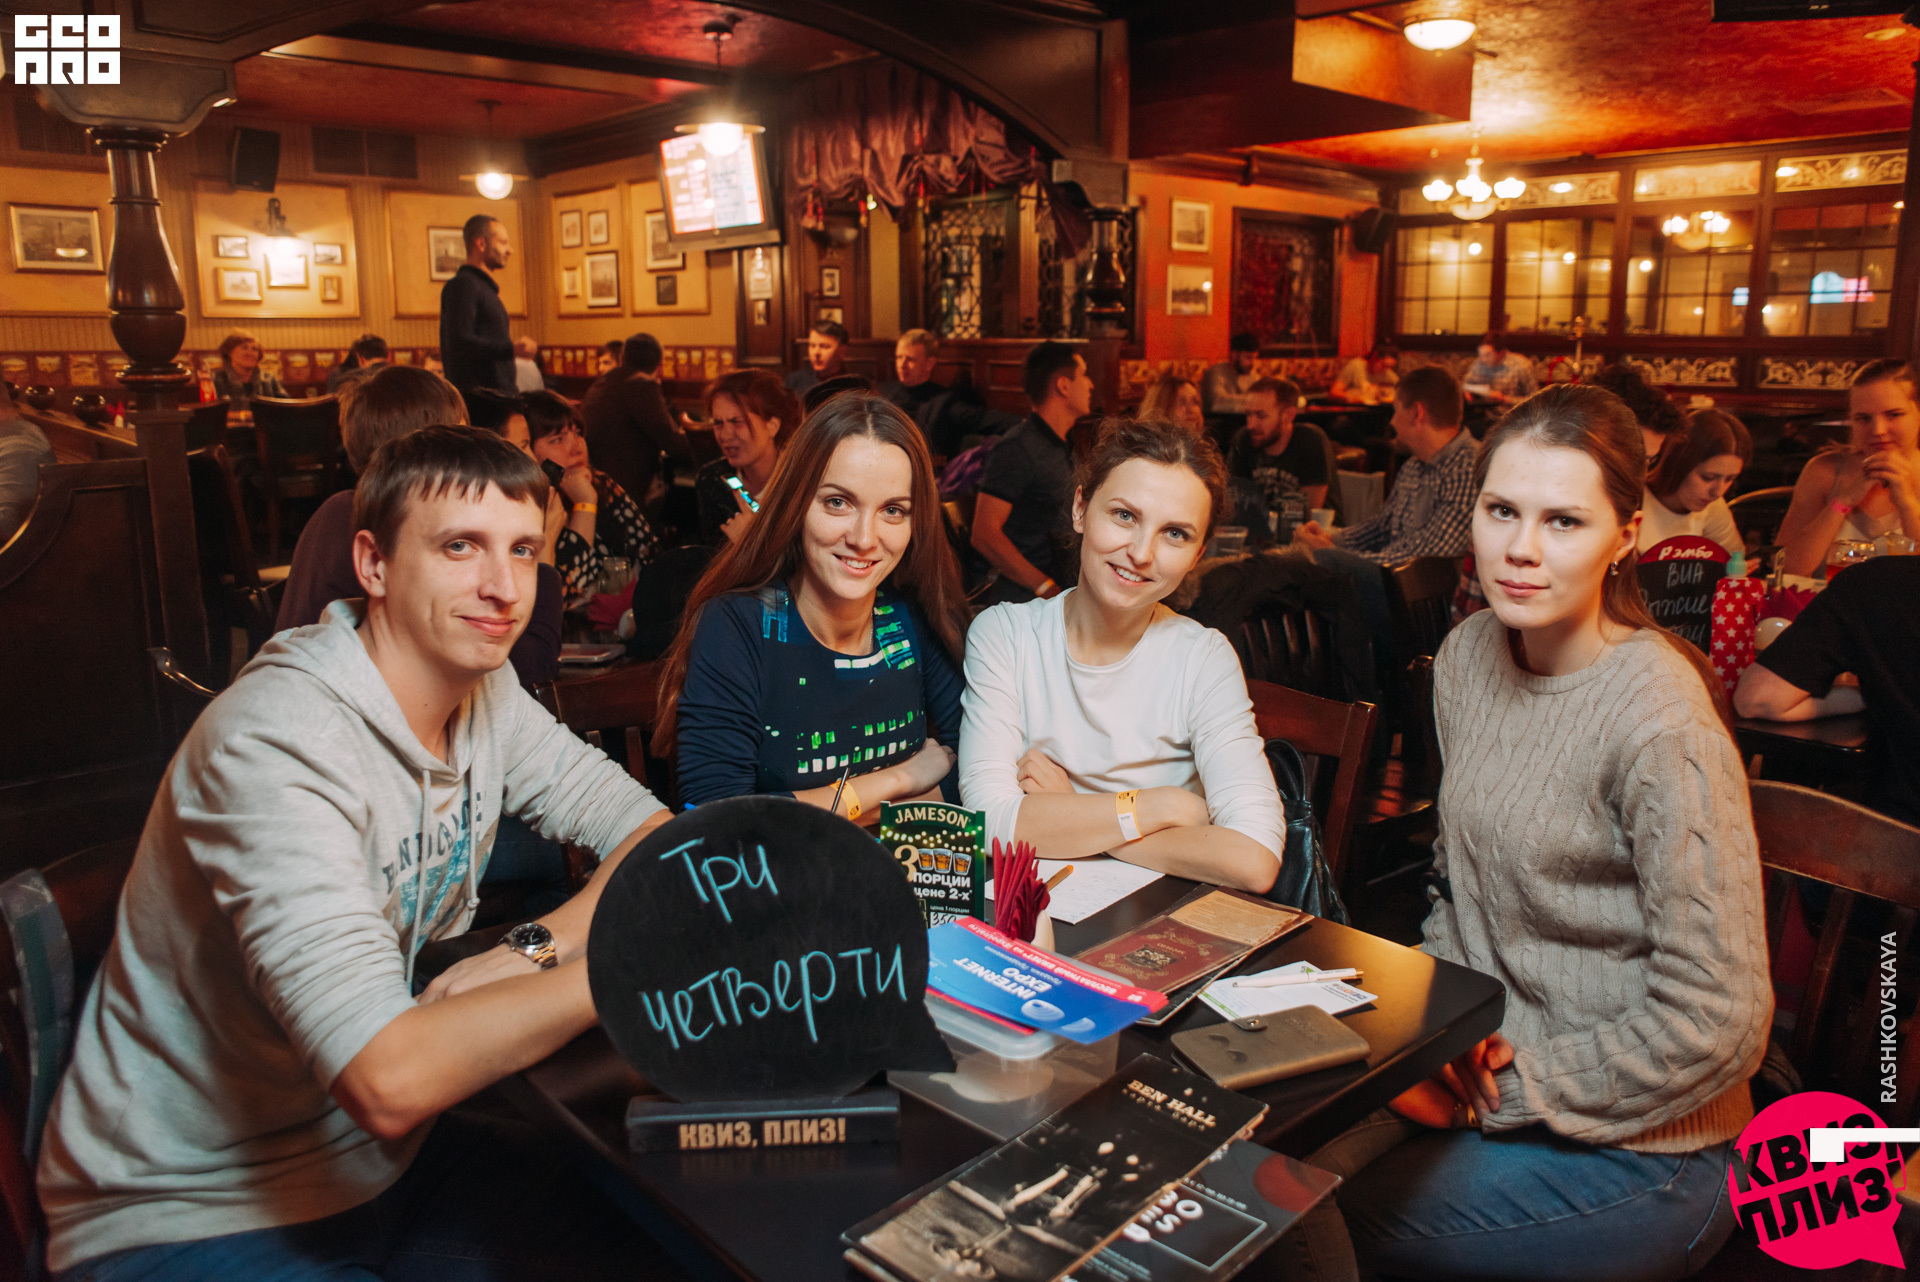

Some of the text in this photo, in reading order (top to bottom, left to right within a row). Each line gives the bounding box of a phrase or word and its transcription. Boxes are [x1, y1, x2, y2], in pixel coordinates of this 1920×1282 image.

[1667, 562, 1704, 588] ВИА
[895, 807, 969, 829] JAMESON
[659, 837, 779, 923] Три
[913, 872, 971, 889] ПОРЦИИ
[953, 957, 1037, 999] INTERNET
[1002, 967, 1053, 993] EXPO
[1054, 966, 1118, 995] БЕСПЛАТНЫЙ
[1127, 1080, 1217, 1128] BEN HALL
[679, 1117, 847, 1149] КВИЗ, ПЛИЗ!
